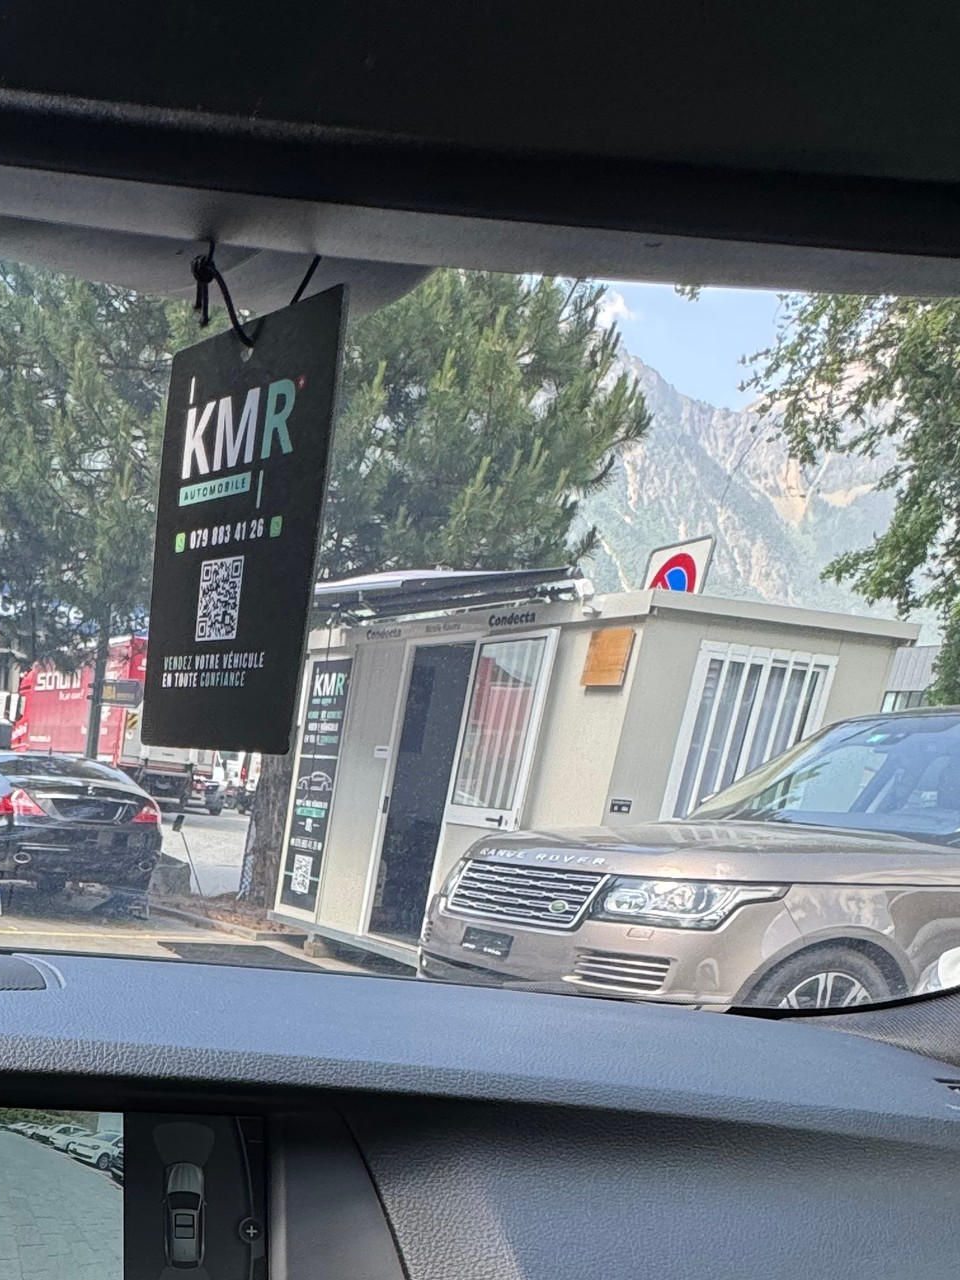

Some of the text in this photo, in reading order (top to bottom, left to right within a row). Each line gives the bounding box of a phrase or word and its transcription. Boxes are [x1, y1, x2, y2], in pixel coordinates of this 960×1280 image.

[181, 376, 297, 480] KMR
[184, 477, 246, 501] AUTOMOBILE
[190, 528, 209, 549] 079
[234, 521, 246, 540] 41
[250, 517, 264, 539] 26
[488, 611, 536, 627] Condecta
[366, 628, 402, 641] Condecta
[164, 650, 266, 671] VENDEZ VOTRE VÉHICULE
[162, 671, 246, 688] EN TOUTE CONFIANCE
[313, 669, 346, 697] KMR
[480, 847, 606, 866] RANGE ROVER
